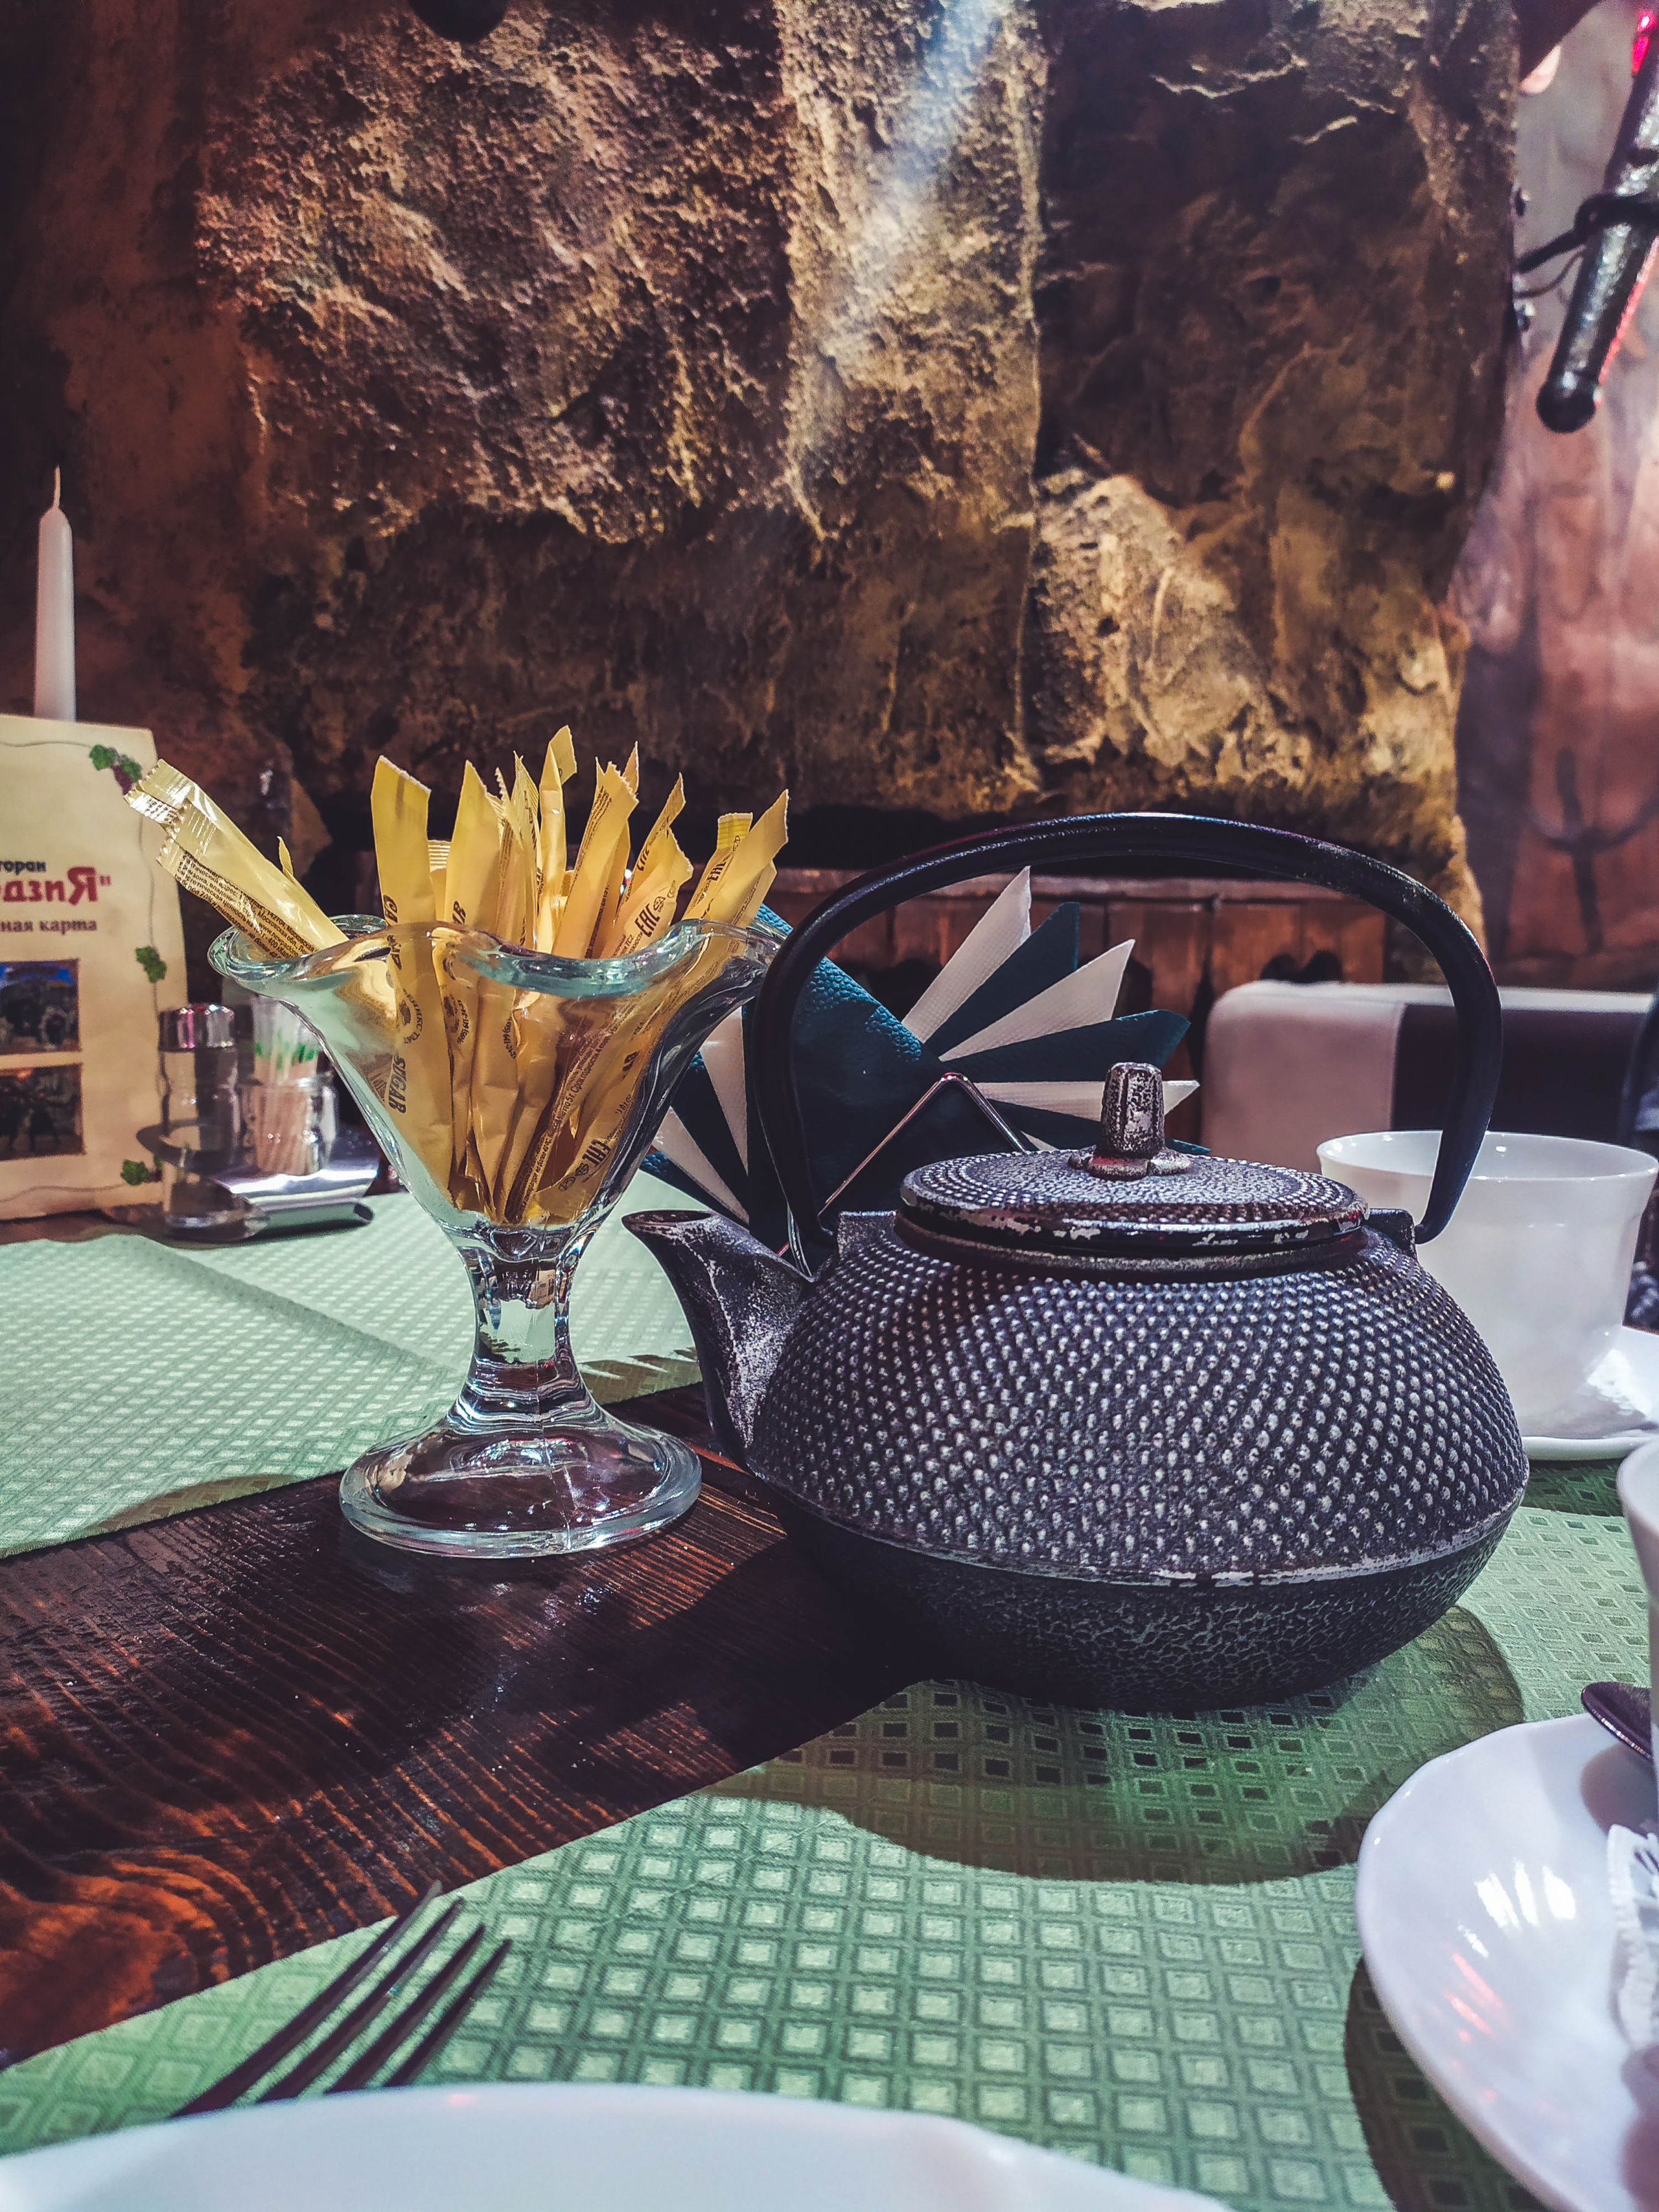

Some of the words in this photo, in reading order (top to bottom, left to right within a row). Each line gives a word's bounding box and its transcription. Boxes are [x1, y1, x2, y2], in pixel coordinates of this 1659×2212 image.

[220, 898, 248, 922] ценность
[256, 908, 288, 938] Московская
[40, 920, 97, 935] карта
[388, 1054, 406, 1113] SUGAR
